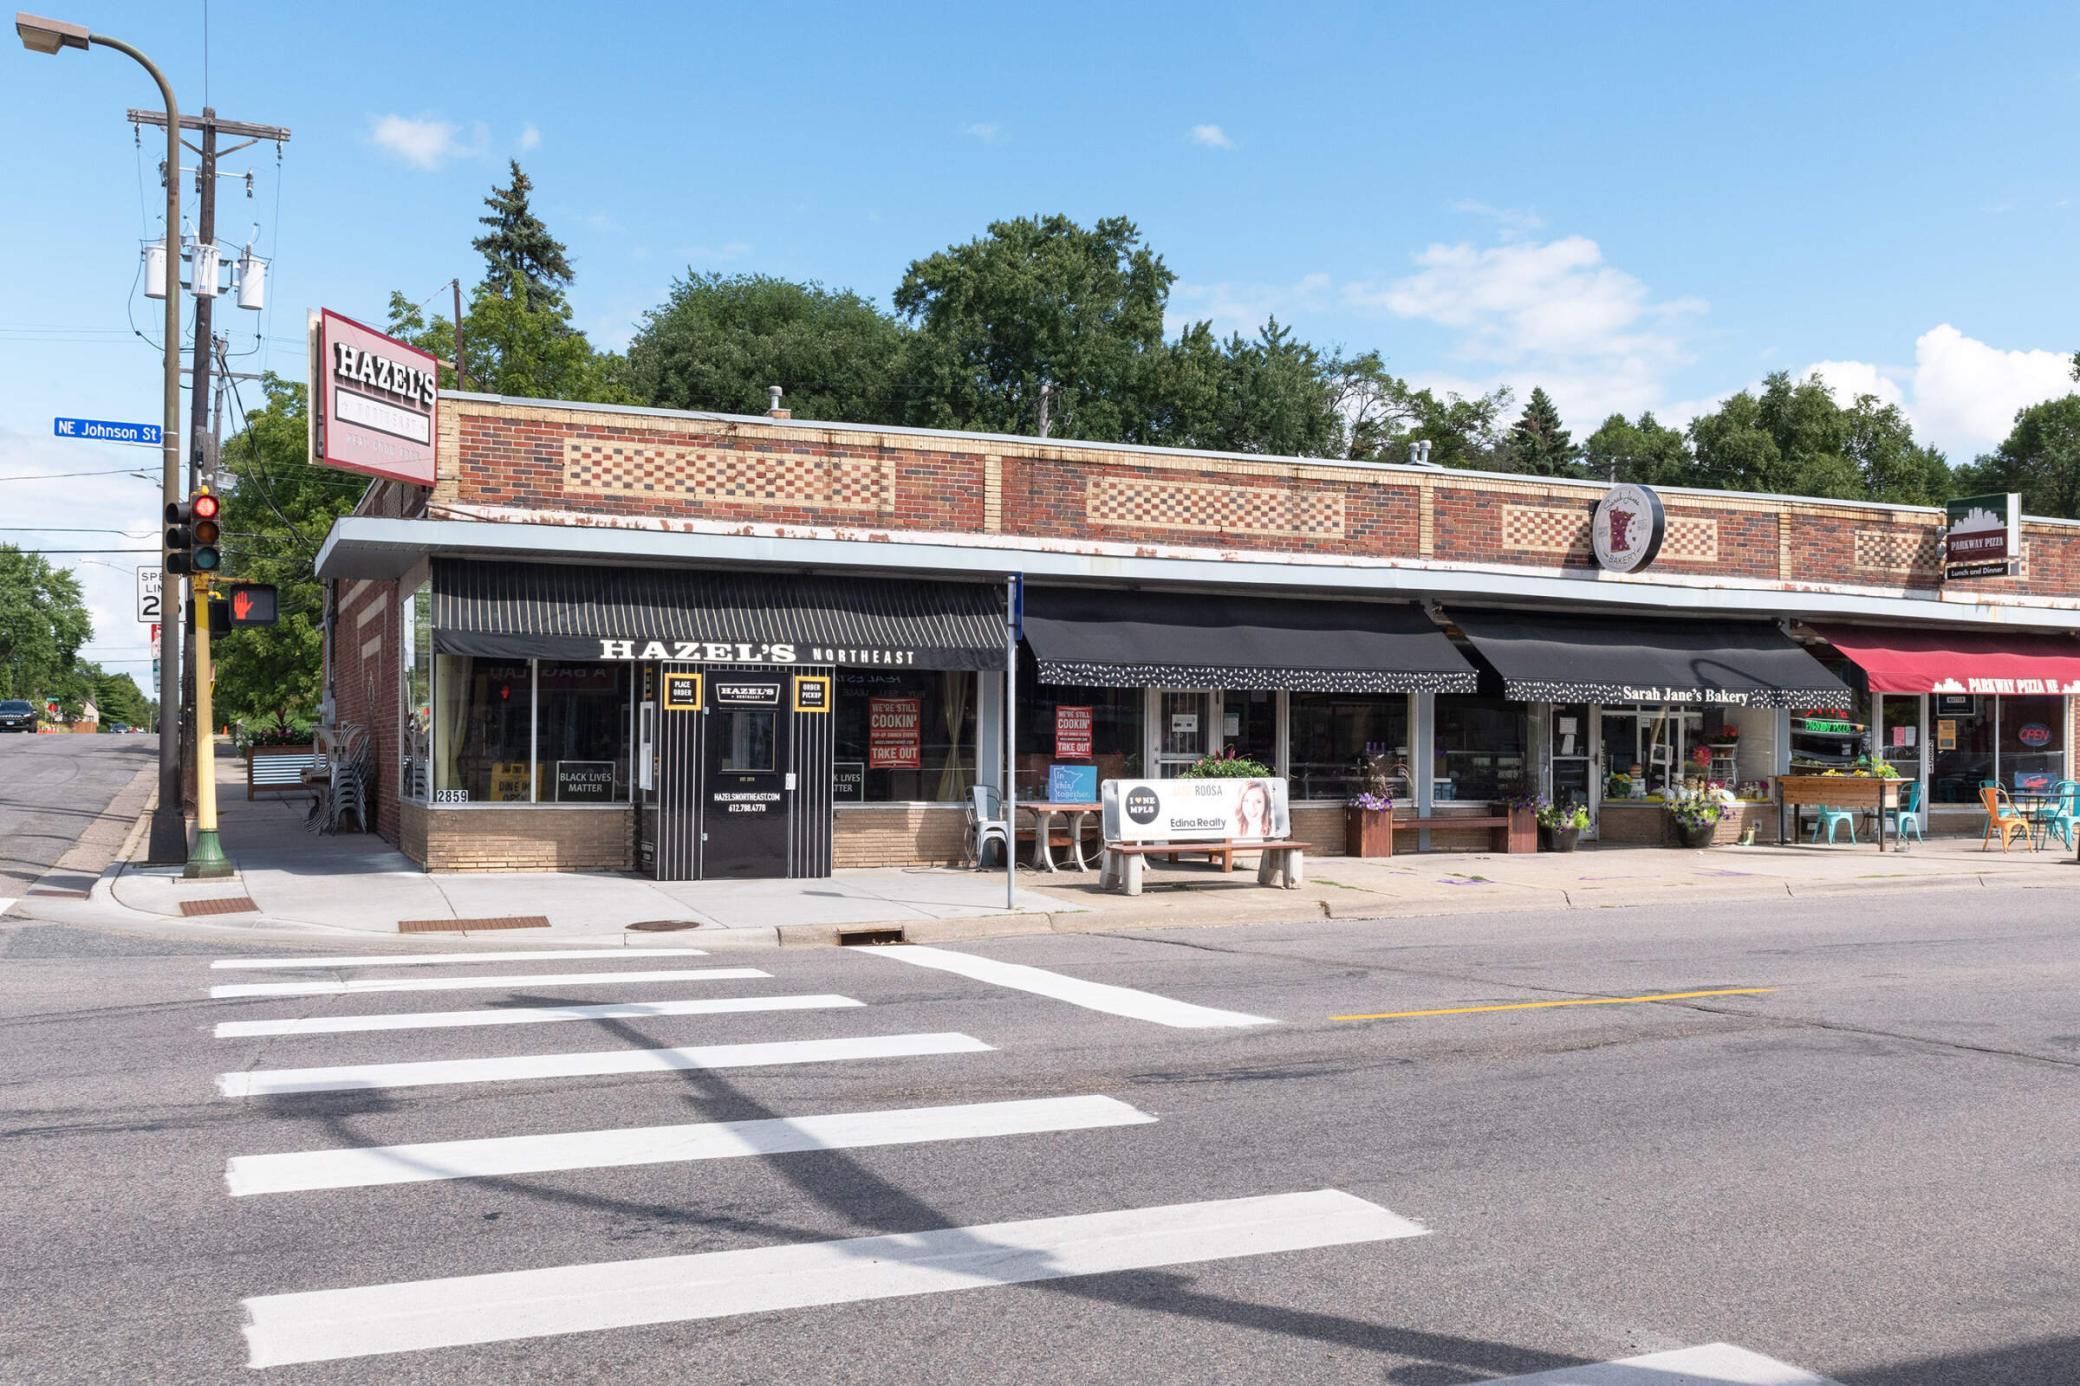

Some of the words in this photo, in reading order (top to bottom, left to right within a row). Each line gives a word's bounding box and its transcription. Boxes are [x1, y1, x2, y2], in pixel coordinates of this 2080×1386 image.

[337, 342, 437, 406] HAZEL'S
[58, 421, 75, 435] NE
[81, 423, 138, 440] Johnson
[142, 428, 157, 441] St
[1951, 539, 1984, 551] PARKWAY
[1984, 536, 2004, 548] PIZZA
[1608, 551, 1637, 565] BAKERY
[142, 572, 162, 581] SPE
[1951, 569, 1969, 577] Lunch
[1970, 567, 1982, 575] and
[1983, 566, 2004, 574] Dinner
[600, 639, 797, 663] HAZEL'S
[813, 648, 914, 664] NORTHEAST
[802, 683, 821, 691] ORDER
[1967, 678, 2015, 693] PARKWAY
[2016, 679, 2045, 693] PIZZA
[673, 689, 692, 697] ORDER
[721, 687, 775, 696] HAZEL'S
[1623, 686, 1661, 701] Sarah
[1663, 687, 1702, 702] Jane's
[1705, 689, 1749, 707] Bakery
[872, 703, 895, 713] WE'RE
[897, 703, 917, 712] STILL
[872, 714, 918, 728] COOKIN'
[1058, 718, 1090, 729] COOKIN'
[2019, 728, 2049, 741] OPEN
[1058, 742, 1075, 752] TAKE
[1077, 742, 1090, 752] OUT
[872, 748, 897, 759] TAKE
[899, 747, 918, 759] OUT
[559, 772, 587, 782] BLACK
[589, 773, 612, 782] LIVES
[840, 773, 861, 783] LIVES
[568, 784, 603, 793] MATTER
[1195, 785, 1223, 797] ROOSA
[437, 790, 468, 803] 2859
[714, 793, 780, 802] HAZELSNORTHEAST.COM
[1129, 797, 1134, 805] I
[1143, 796, 1156, 805] NE
[1130, 806, 1154, 814] MPLS
[1170, 818, 1196, 828] Edina
[1197, 818, 1227, 830] Realty
